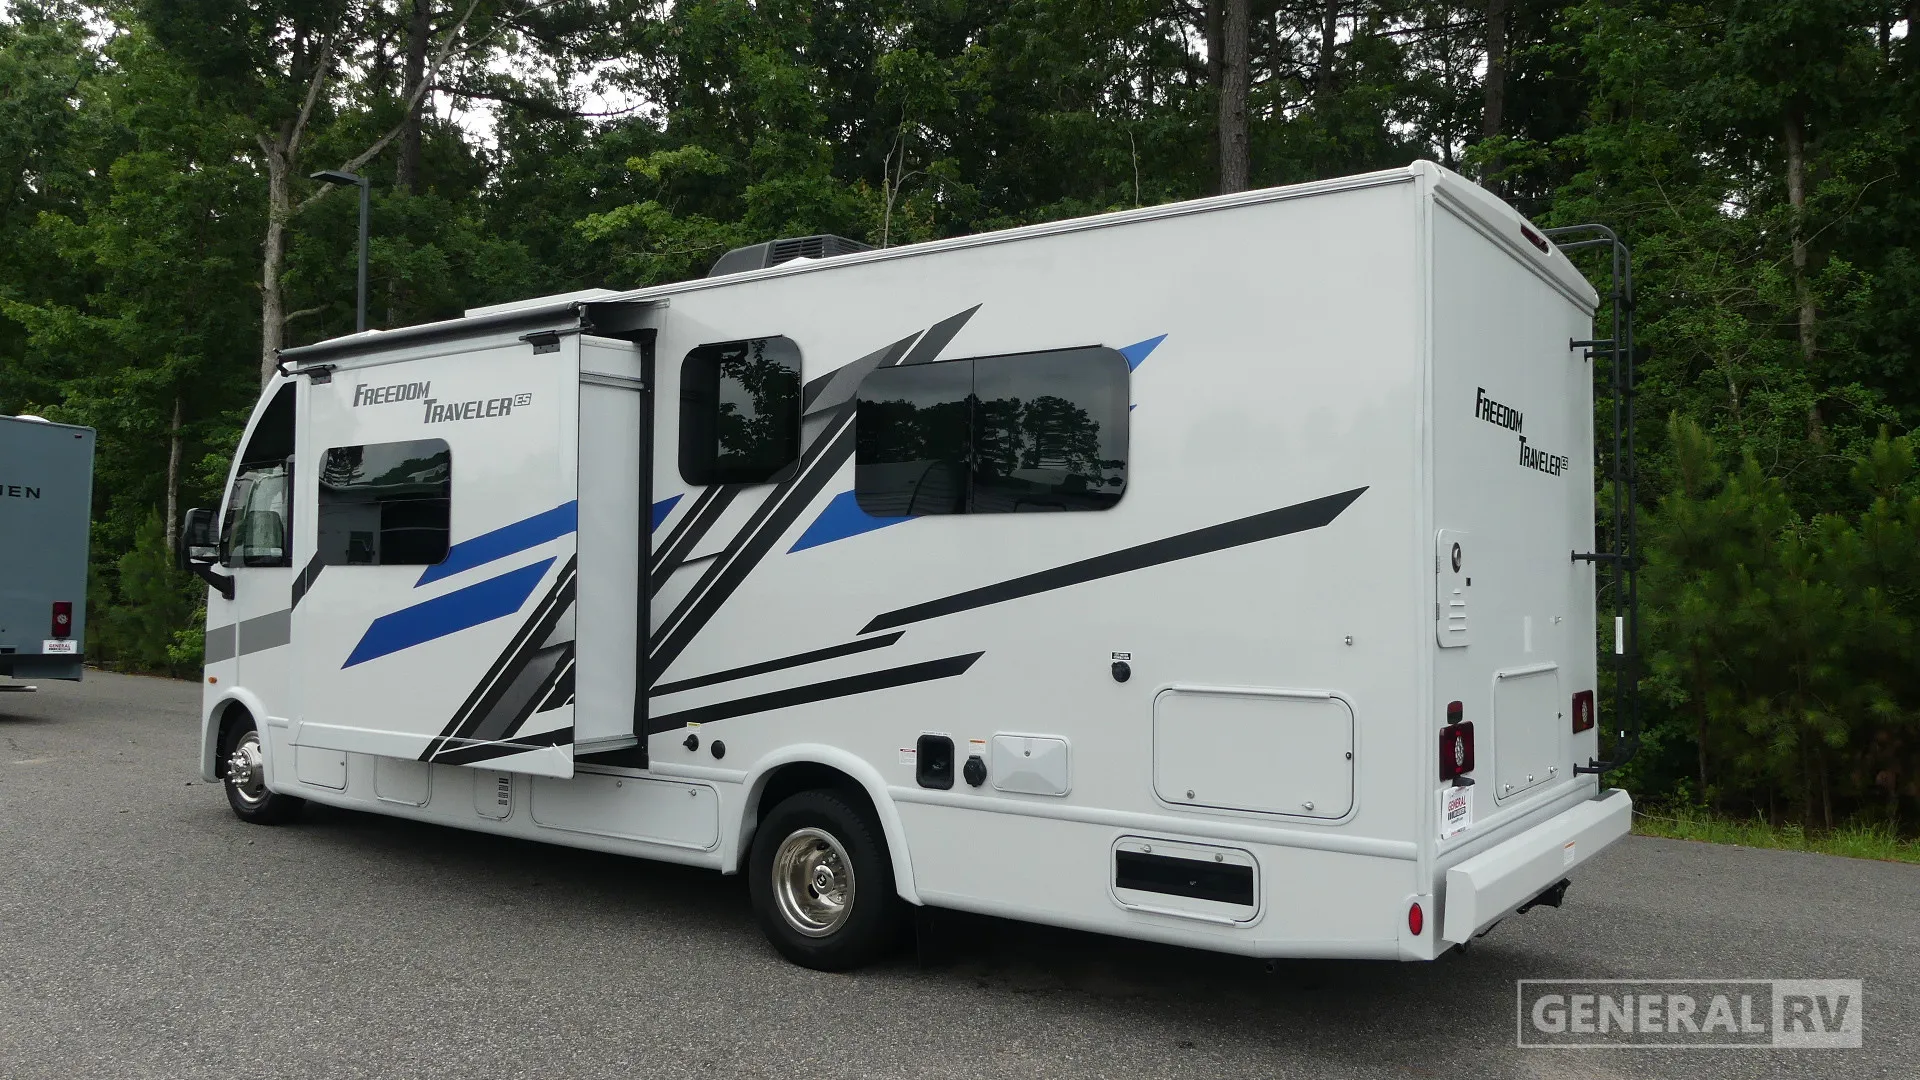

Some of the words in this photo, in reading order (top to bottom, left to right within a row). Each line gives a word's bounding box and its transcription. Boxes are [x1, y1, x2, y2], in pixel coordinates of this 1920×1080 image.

[353, 381, 431, 408] FREEDOM
[424, 397, 513, 424] TRAVELER
[1475, 386, 1523, 434] FREEDOM
[1519, 435, 1561, 477] TRAVELER
[0, 484, 40, 499] EN
